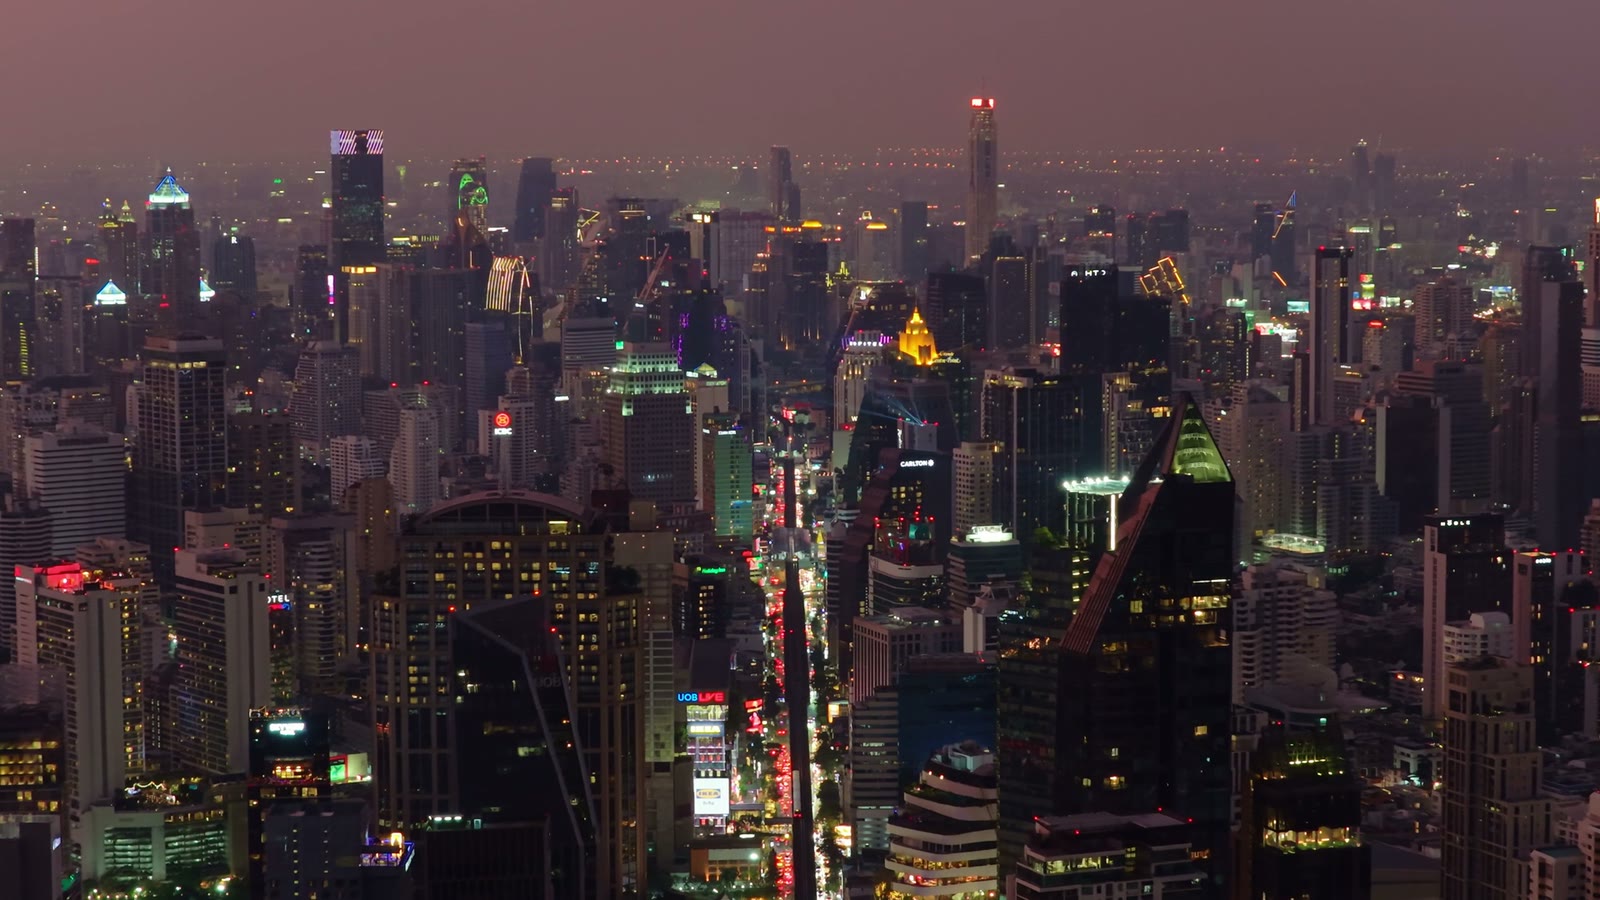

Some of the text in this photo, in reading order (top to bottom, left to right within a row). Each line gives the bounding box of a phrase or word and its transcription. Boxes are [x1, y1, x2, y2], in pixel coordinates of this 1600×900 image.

[494, 427, 513, 435] ICBC
[677, 692, 724, 702] UOB LIVE
